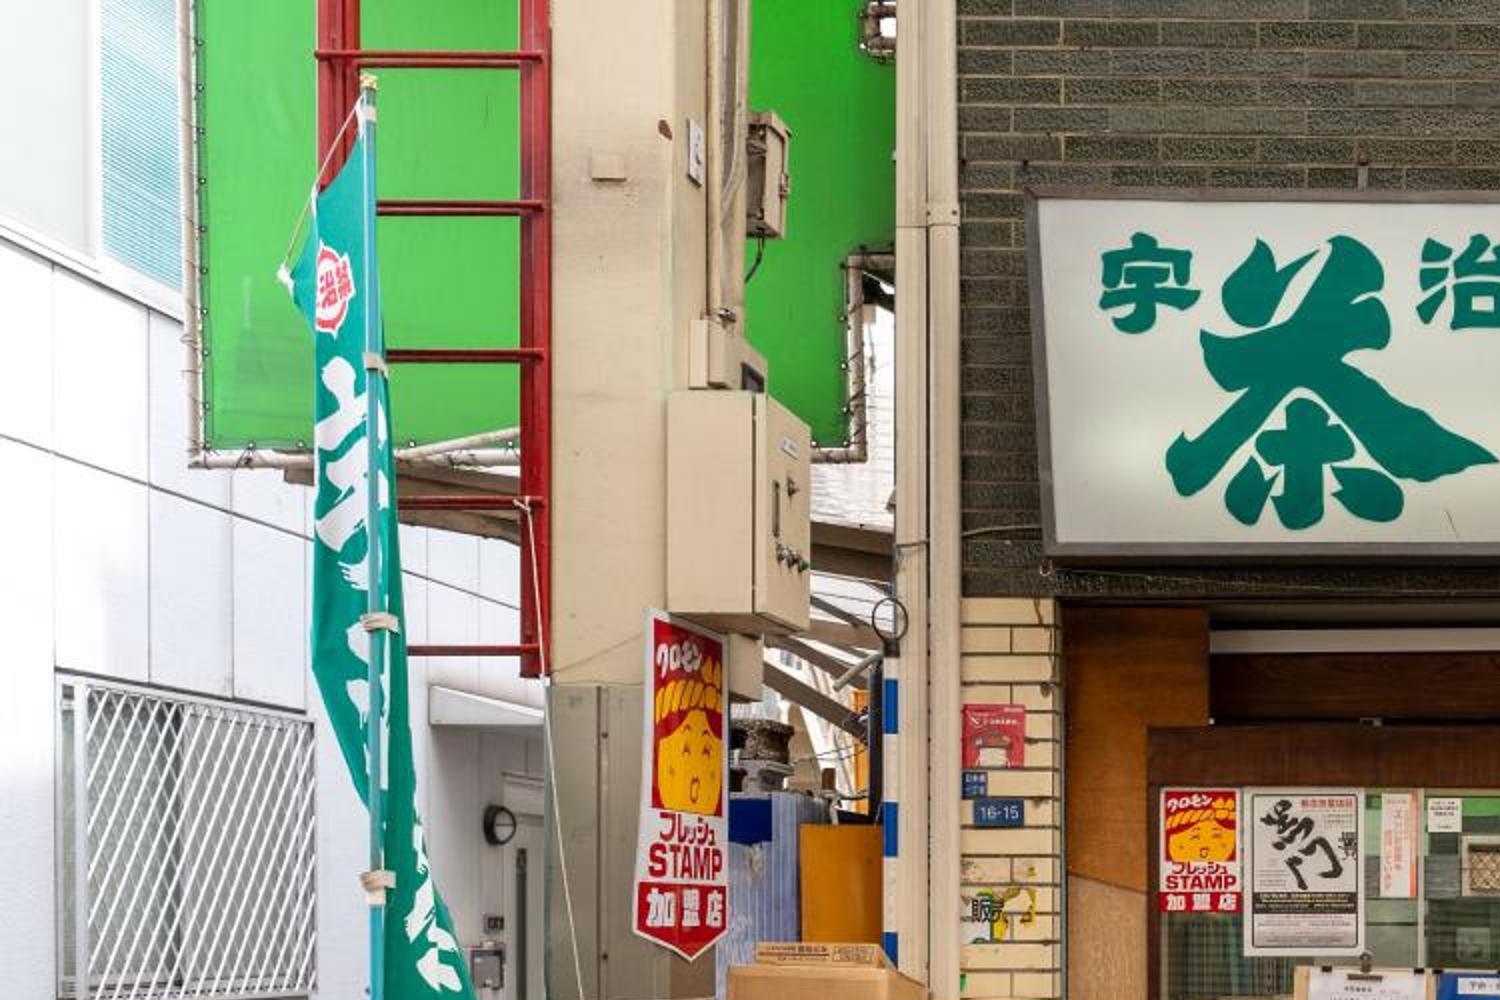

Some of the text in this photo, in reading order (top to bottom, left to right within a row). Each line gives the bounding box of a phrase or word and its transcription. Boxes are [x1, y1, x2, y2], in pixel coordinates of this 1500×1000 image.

[656, 640, 703, 679] クロモン
[1167, 794, 1213, 812] クロモン
[980, 806, 1019, 820] 16-15
[659, 811, 717, 847] フレッシュ
[648, 842, 723, 882] STAMP
[1171, 861, 1229, 875] フレッシュ
[1166, 875, 1238, 890] STAMP
[646, 887, 723, 929] 加盟店
[1166, 894, 1237, 912] 加盟店
